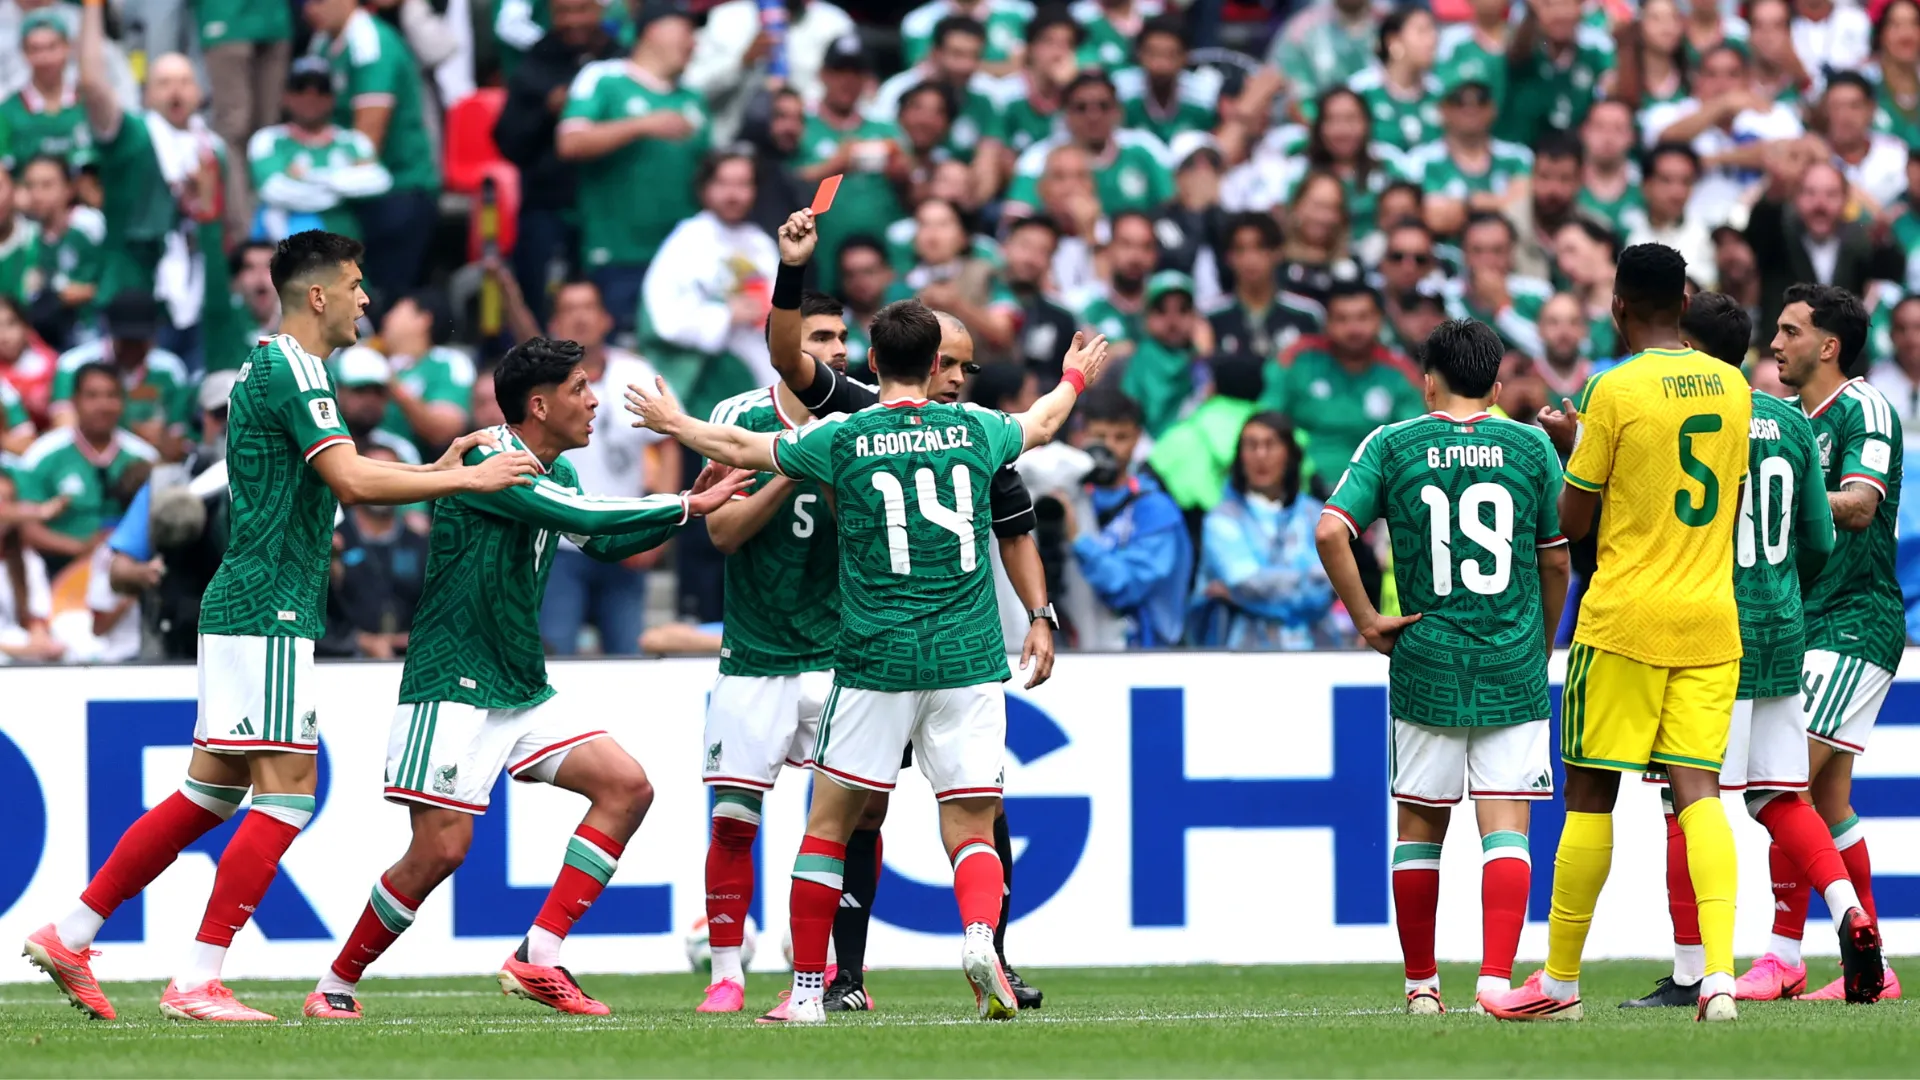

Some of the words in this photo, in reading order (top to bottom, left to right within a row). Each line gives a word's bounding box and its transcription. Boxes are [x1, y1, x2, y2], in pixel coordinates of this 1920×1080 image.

[1661, 373, 1725, 399] MBATHA
[856, 425, 973, 457] A.GONZÁLEZ
[1427, 445, 1504, 468] G.MORA
[1674, 413, 1722, 527] 5
[792, 494, 817, 538] 5
[871, 464, 977, 575] 14
[1420, 482, 1514, 596] 19
[1737, 456, 1794, 568] 10
